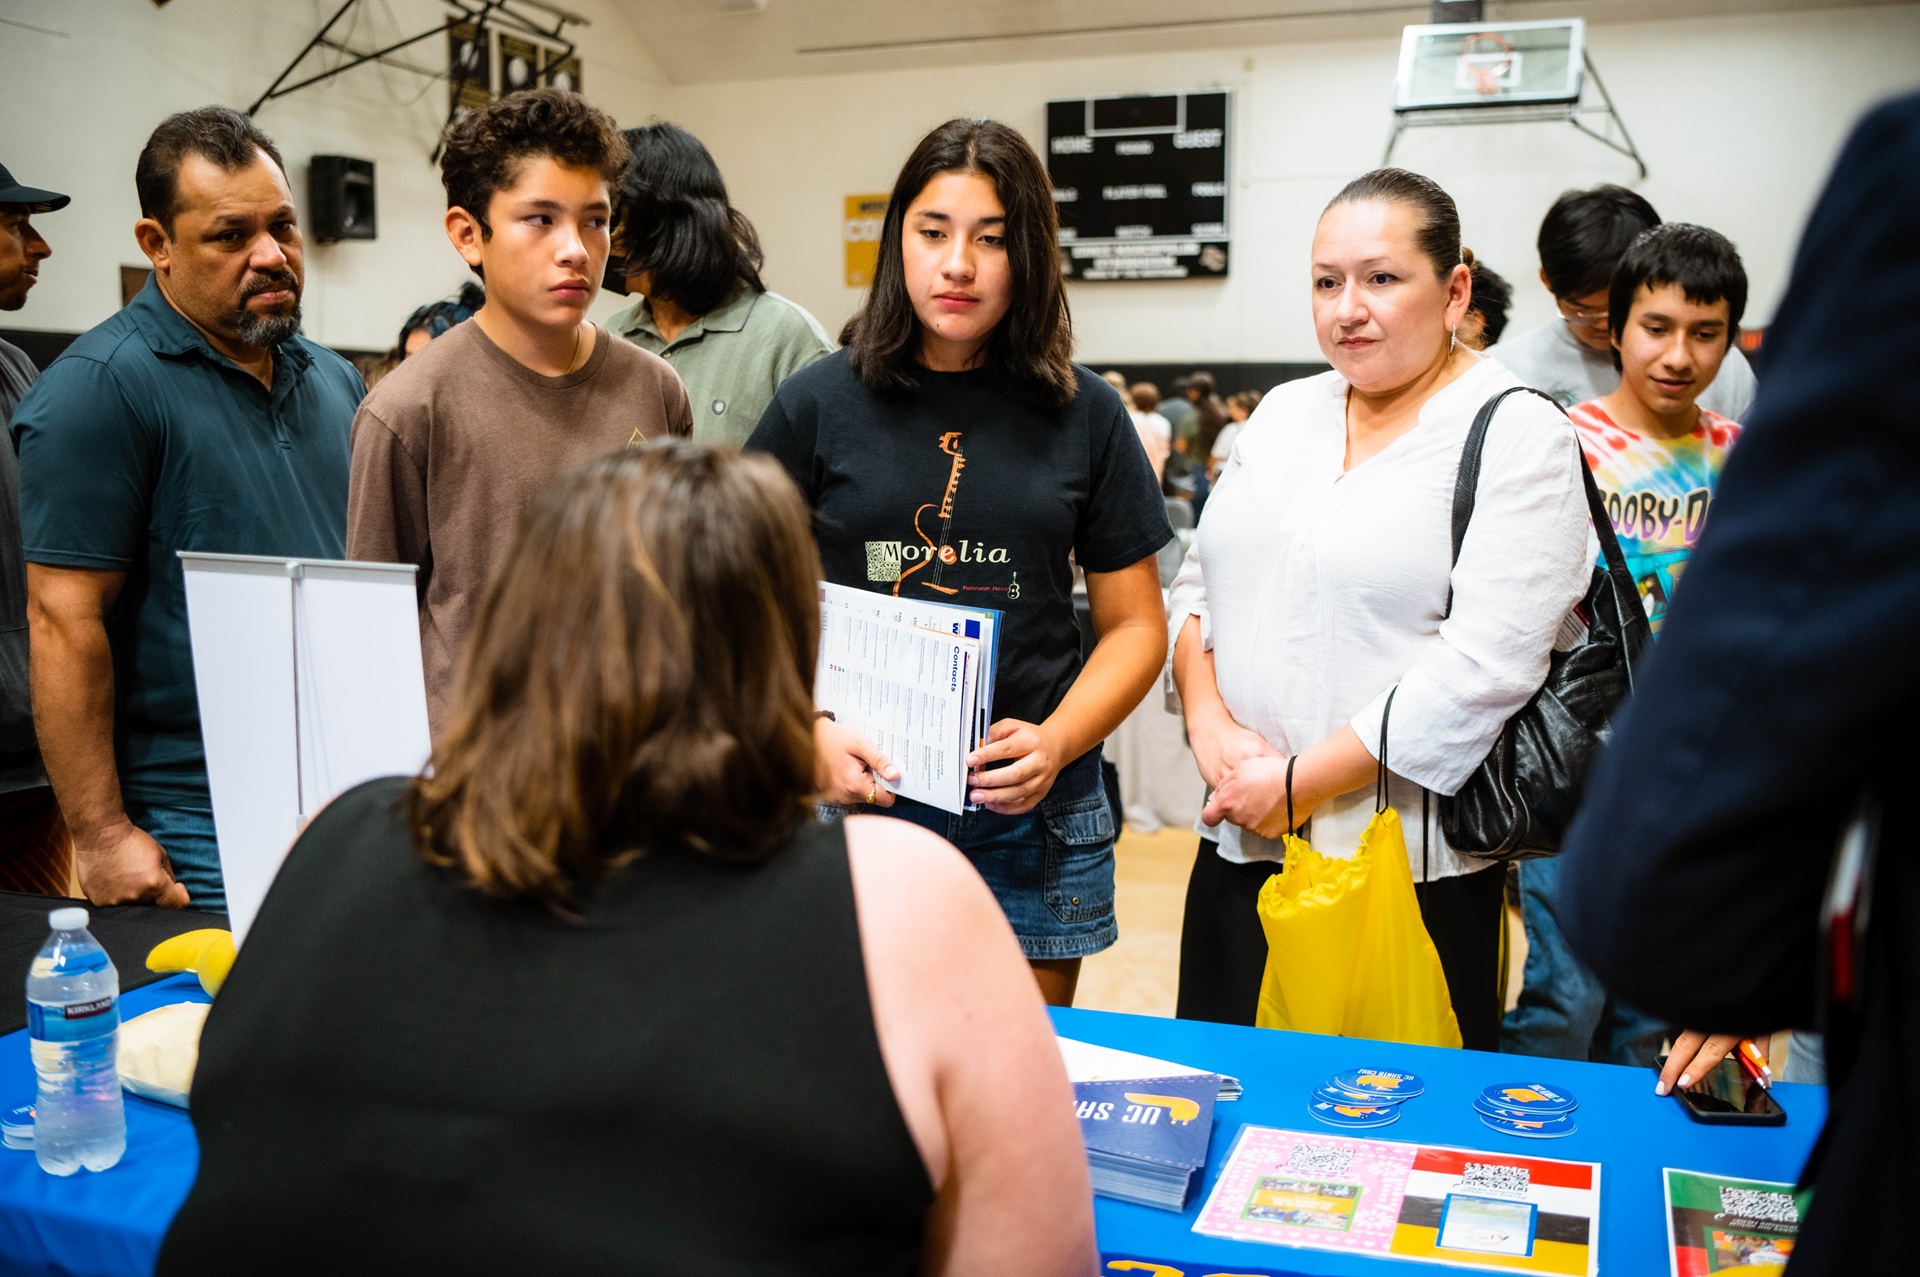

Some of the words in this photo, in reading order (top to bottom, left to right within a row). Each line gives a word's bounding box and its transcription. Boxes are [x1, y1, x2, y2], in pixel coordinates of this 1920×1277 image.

[1051, 136, 1095, 155] HOME
[1173, 129, 1223, 149] GUEST
[883, 540, 1011, 563] Morelia
[950, 646, 960, 693] Contacts
[66, 998, 112, 1015] KIRKLAND
[1357, 1068, 1378, 1076] CRUZ
[1378, 1071, 1402, 1079] SANTA
[1122, 1104, 1161, 1125] UC
